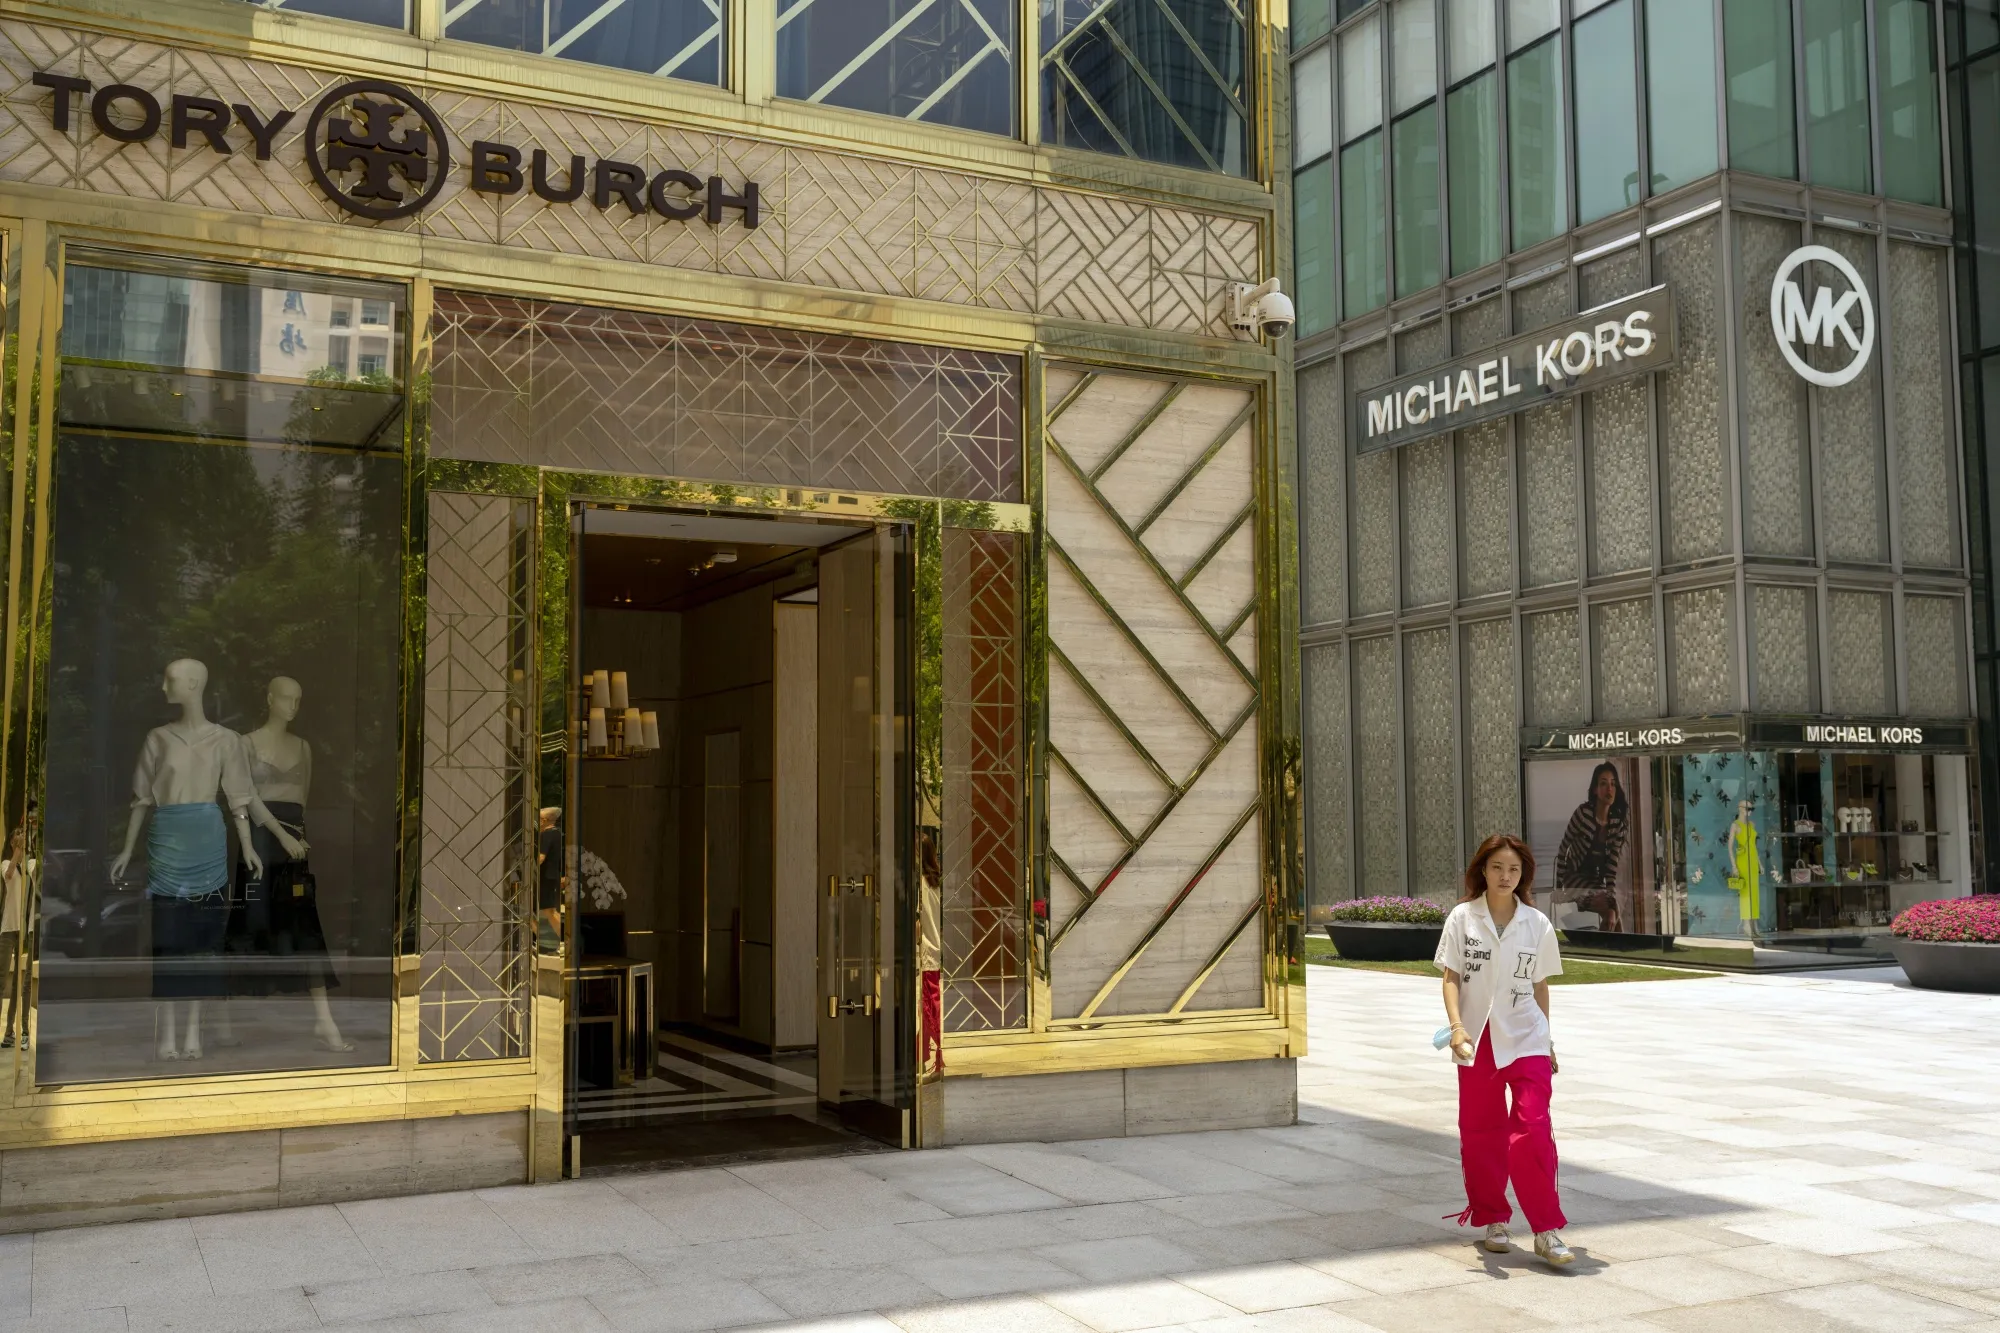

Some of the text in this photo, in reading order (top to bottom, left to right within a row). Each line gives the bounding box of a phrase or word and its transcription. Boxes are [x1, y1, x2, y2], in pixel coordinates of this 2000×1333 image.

[32, 72, 759, 230] TORY BURCH
[1367, 310, 1656, 438] MICHAEL KORS
[1568, 728, 1682, 749] MICHAEL KORS
[1806, 725, 1923, 744] MICHAEL KORS
[1716, 753, 1731, 770] MK
[1688, 789, 1702, 808] MK
[1717, 789, 1731, 808] MK
[1473, 949, 1491, 960] and
